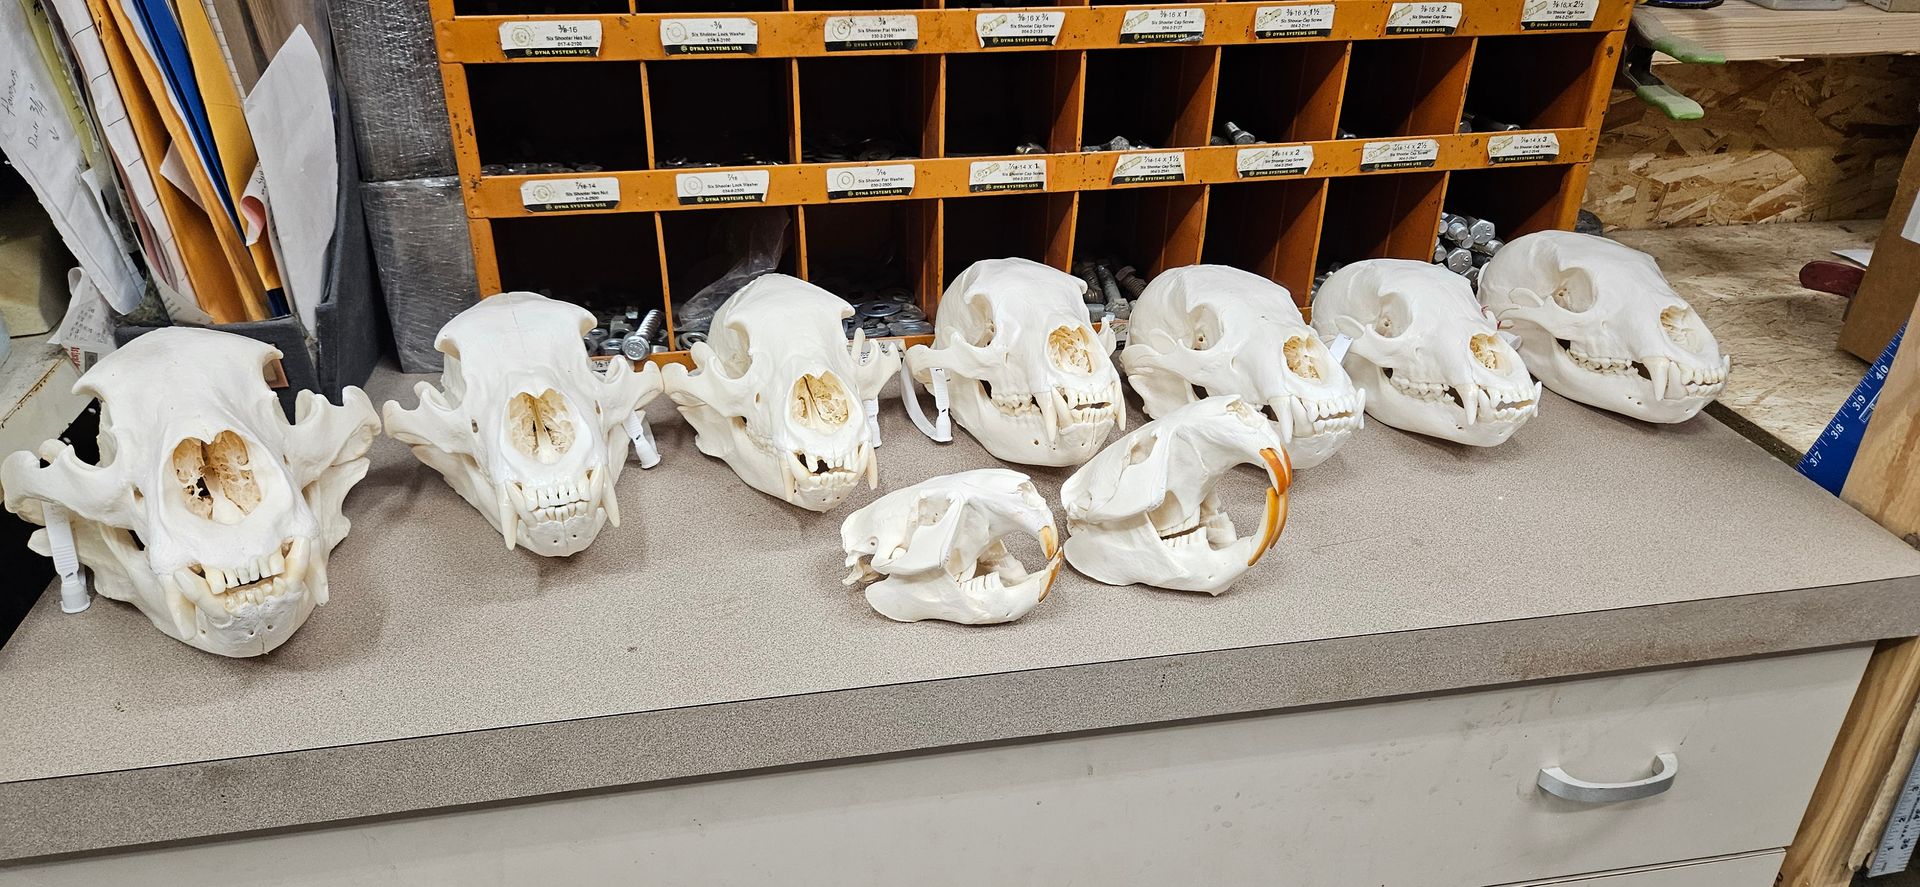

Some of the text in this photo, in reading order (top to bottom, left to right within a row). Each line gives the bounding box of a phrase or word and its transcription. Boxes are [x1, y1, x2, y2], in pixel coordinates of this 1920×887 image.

[1809, 364, 1889, 467] 37 38 39 40
